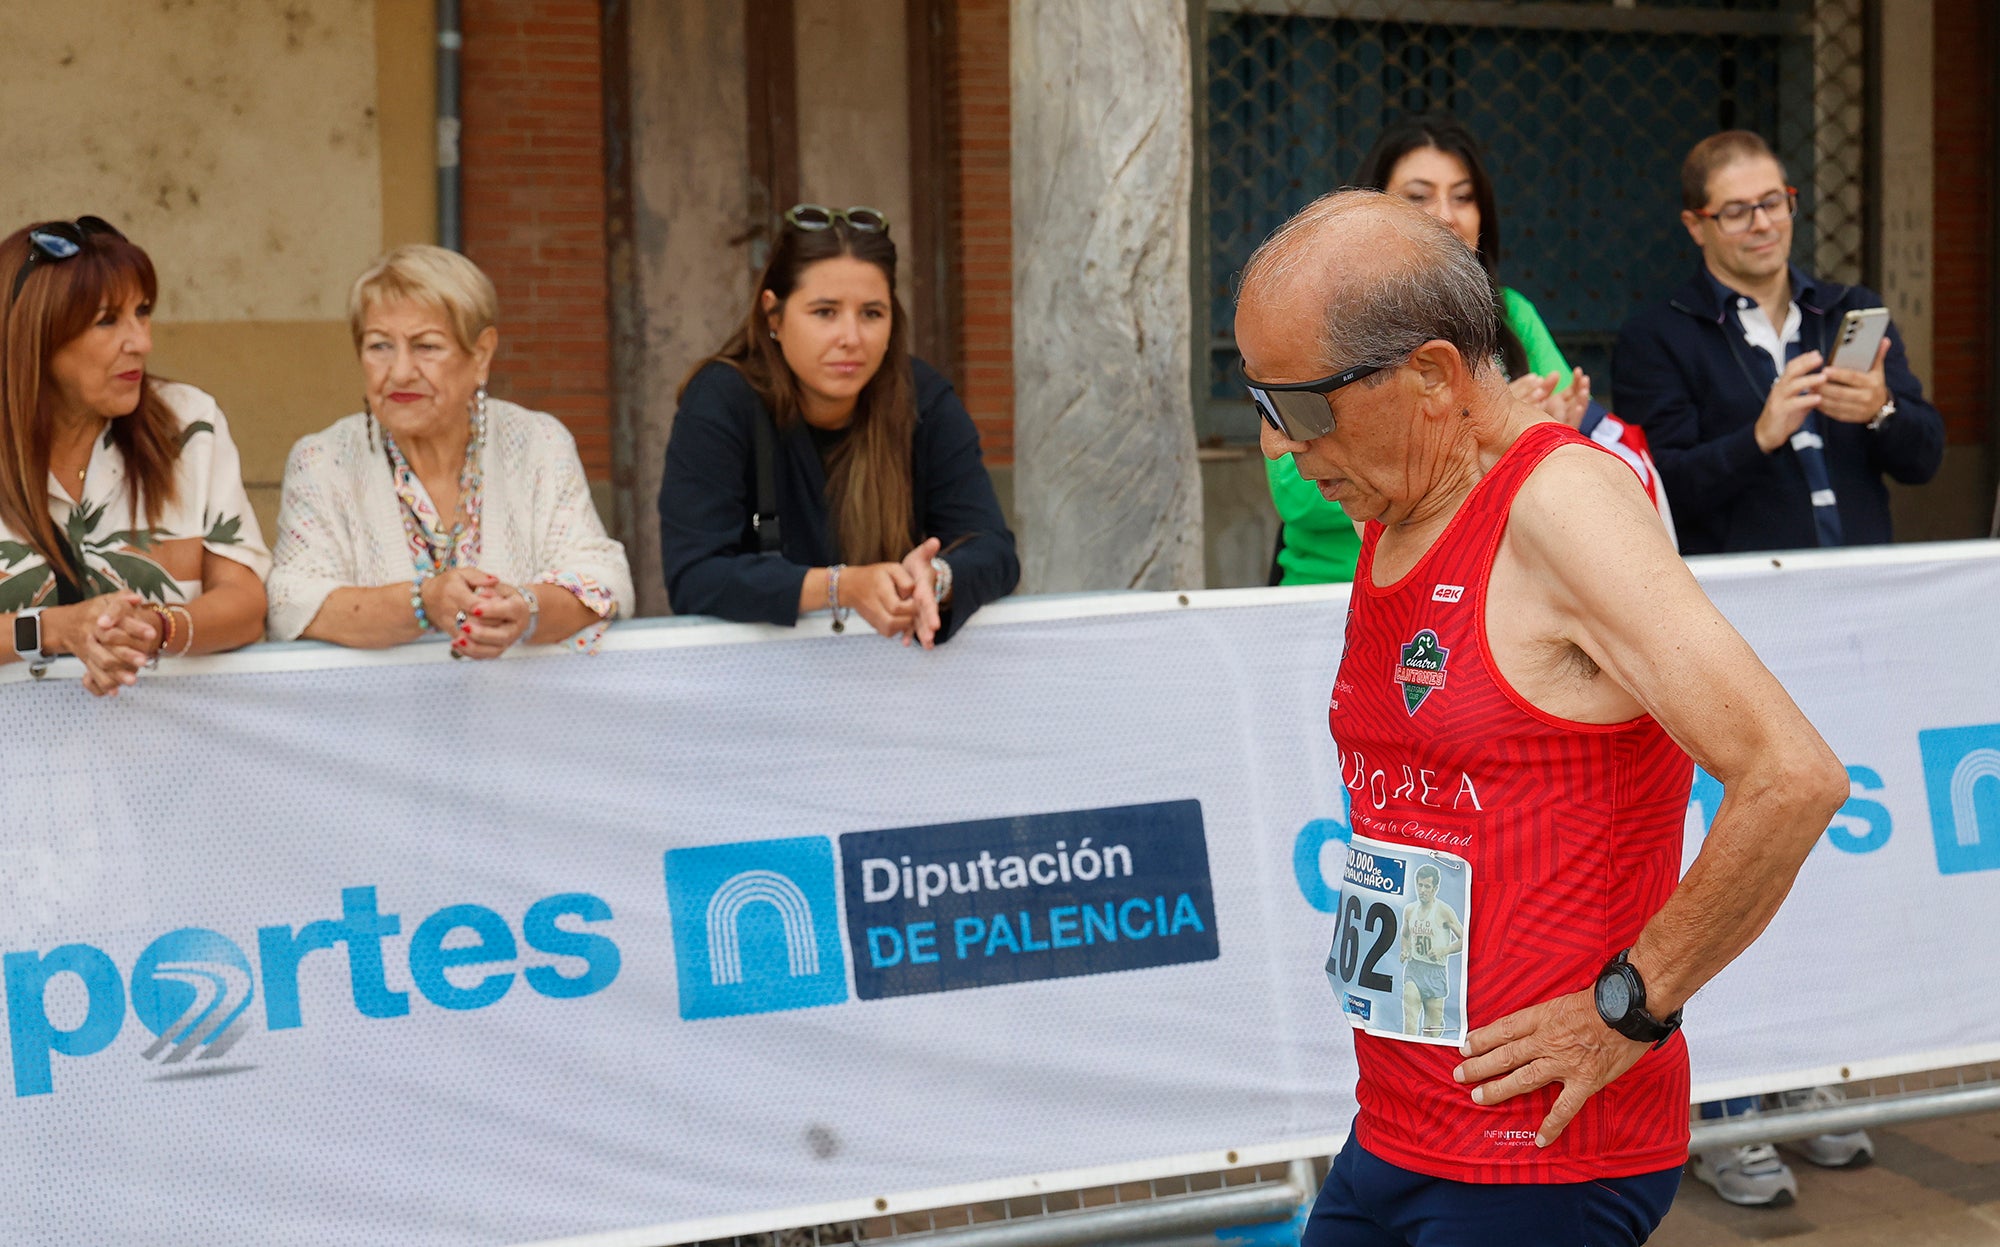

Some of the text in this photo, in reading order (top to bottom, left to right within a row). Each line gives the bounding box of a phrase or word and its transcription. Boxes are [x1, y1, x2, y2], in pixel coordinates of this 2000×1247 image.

[1435, 588, 1461, 599] 42K
[1401, 820, 1473, 847] Calidad
[861, 837, 1134, 908] Diputación
[1372, 867, 1383, 877] de
[1363, 873, 1394, 891] HARO
[866, 893, 1205, 969] DE PALENCIA
[1415, 935, 1432, 956] 50
[1483, 1130, 1536, 1139] INFINITECH
